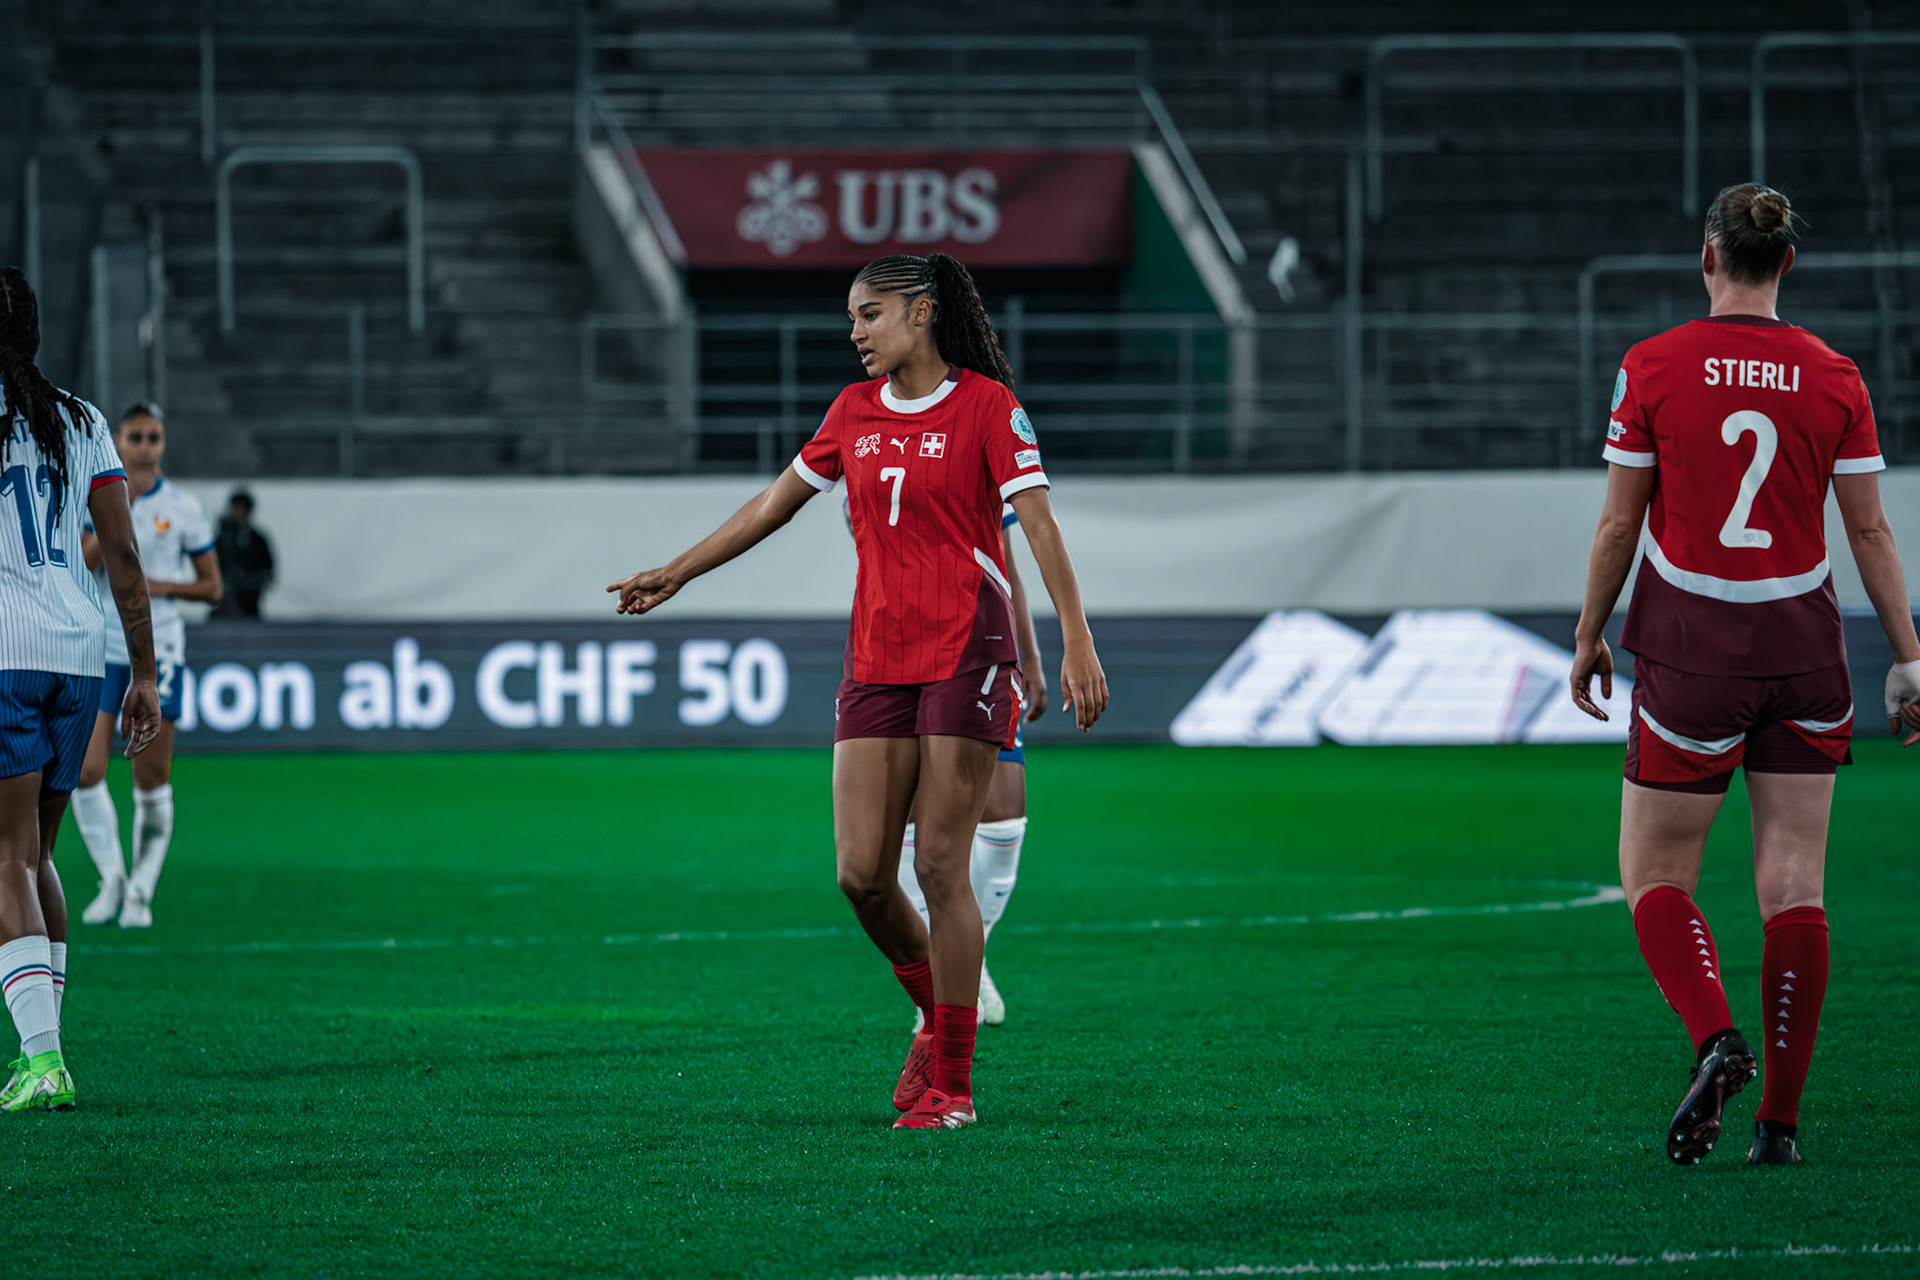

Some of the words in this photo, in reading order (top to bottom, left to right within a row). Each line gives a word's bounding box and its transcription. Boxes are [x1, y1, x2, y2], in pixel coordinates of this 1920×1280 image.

[836, 168, 999, 244] UBS
[1704, 357, 1800, 392] STIERLI
[0, 464, 68, 568] 12
[880, 467, 906, 526] 7
[1719, 410, 1778, 549] 2
[339, 637, 455, 731] ab
[475, 640, 657, 729] CHF
[678, 638, 789, 727] 50
